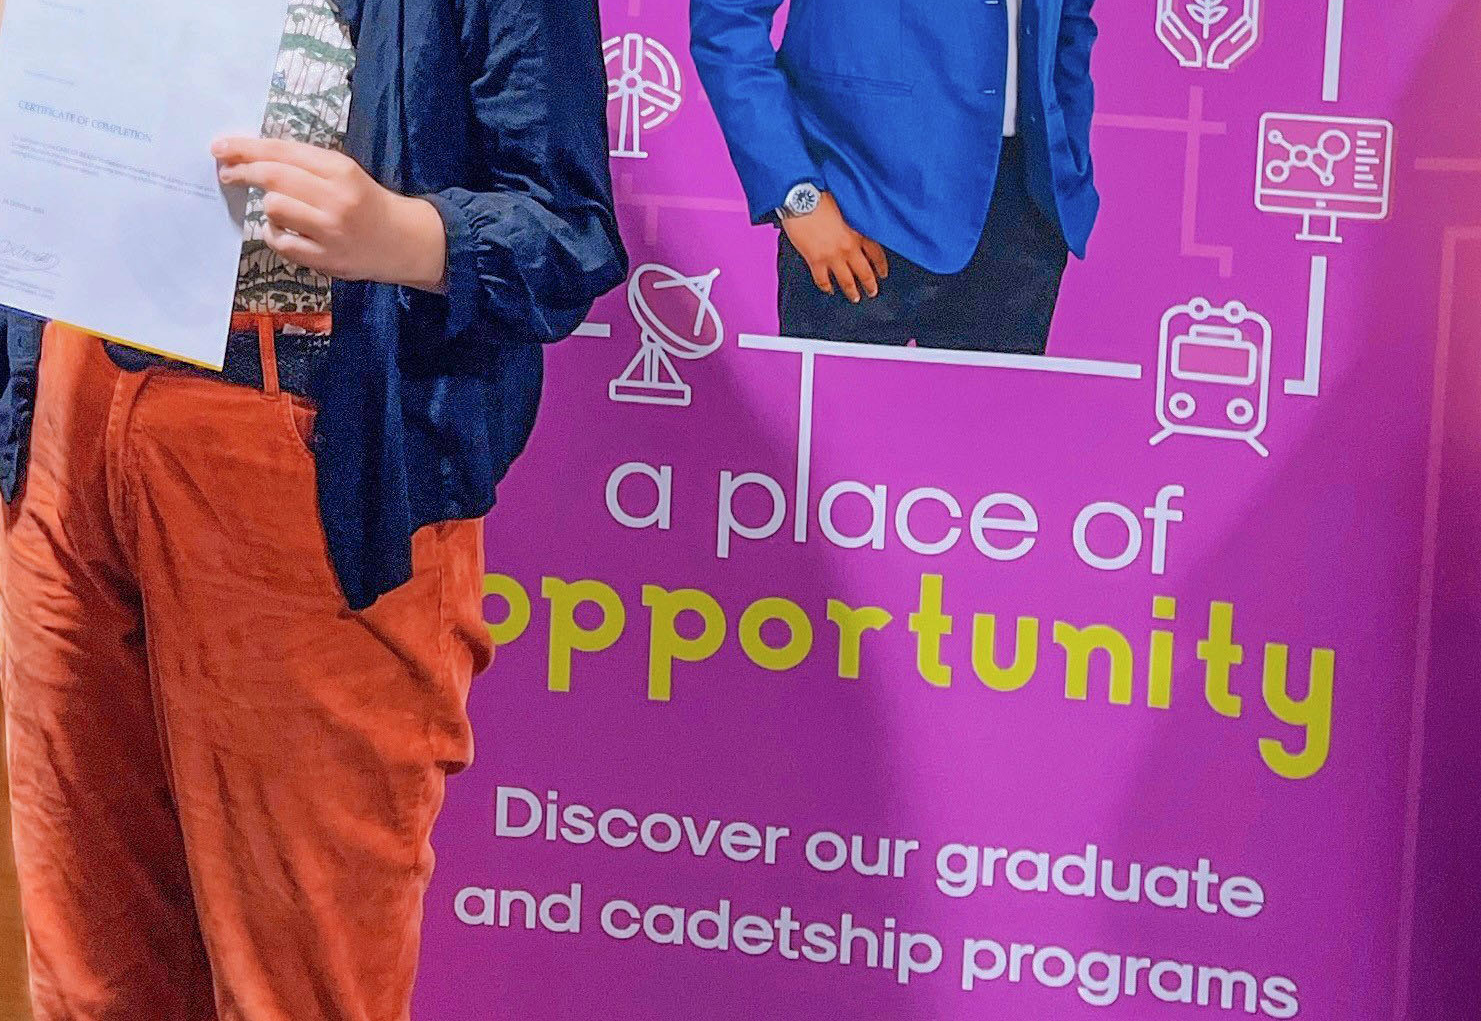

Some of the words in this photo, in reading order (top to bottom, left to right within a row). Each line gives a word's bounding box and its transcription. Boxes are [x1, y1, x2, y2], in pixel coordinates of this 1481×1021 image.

[604, 461, 673, 531] a
[716, 430, 1039, 560] place
[1072, 484, 1185, 575] of
[482, 572, 1335, 780] opportunity
[494, 785, 790, 865] Discover
[804, 830, 919, 878] our
[935, 842, 1265, 919] graduate
[453, 882, 582, 934] and
[600, 898, 943, 984] cadetship
[961, 937, 1299, 1020] programs
